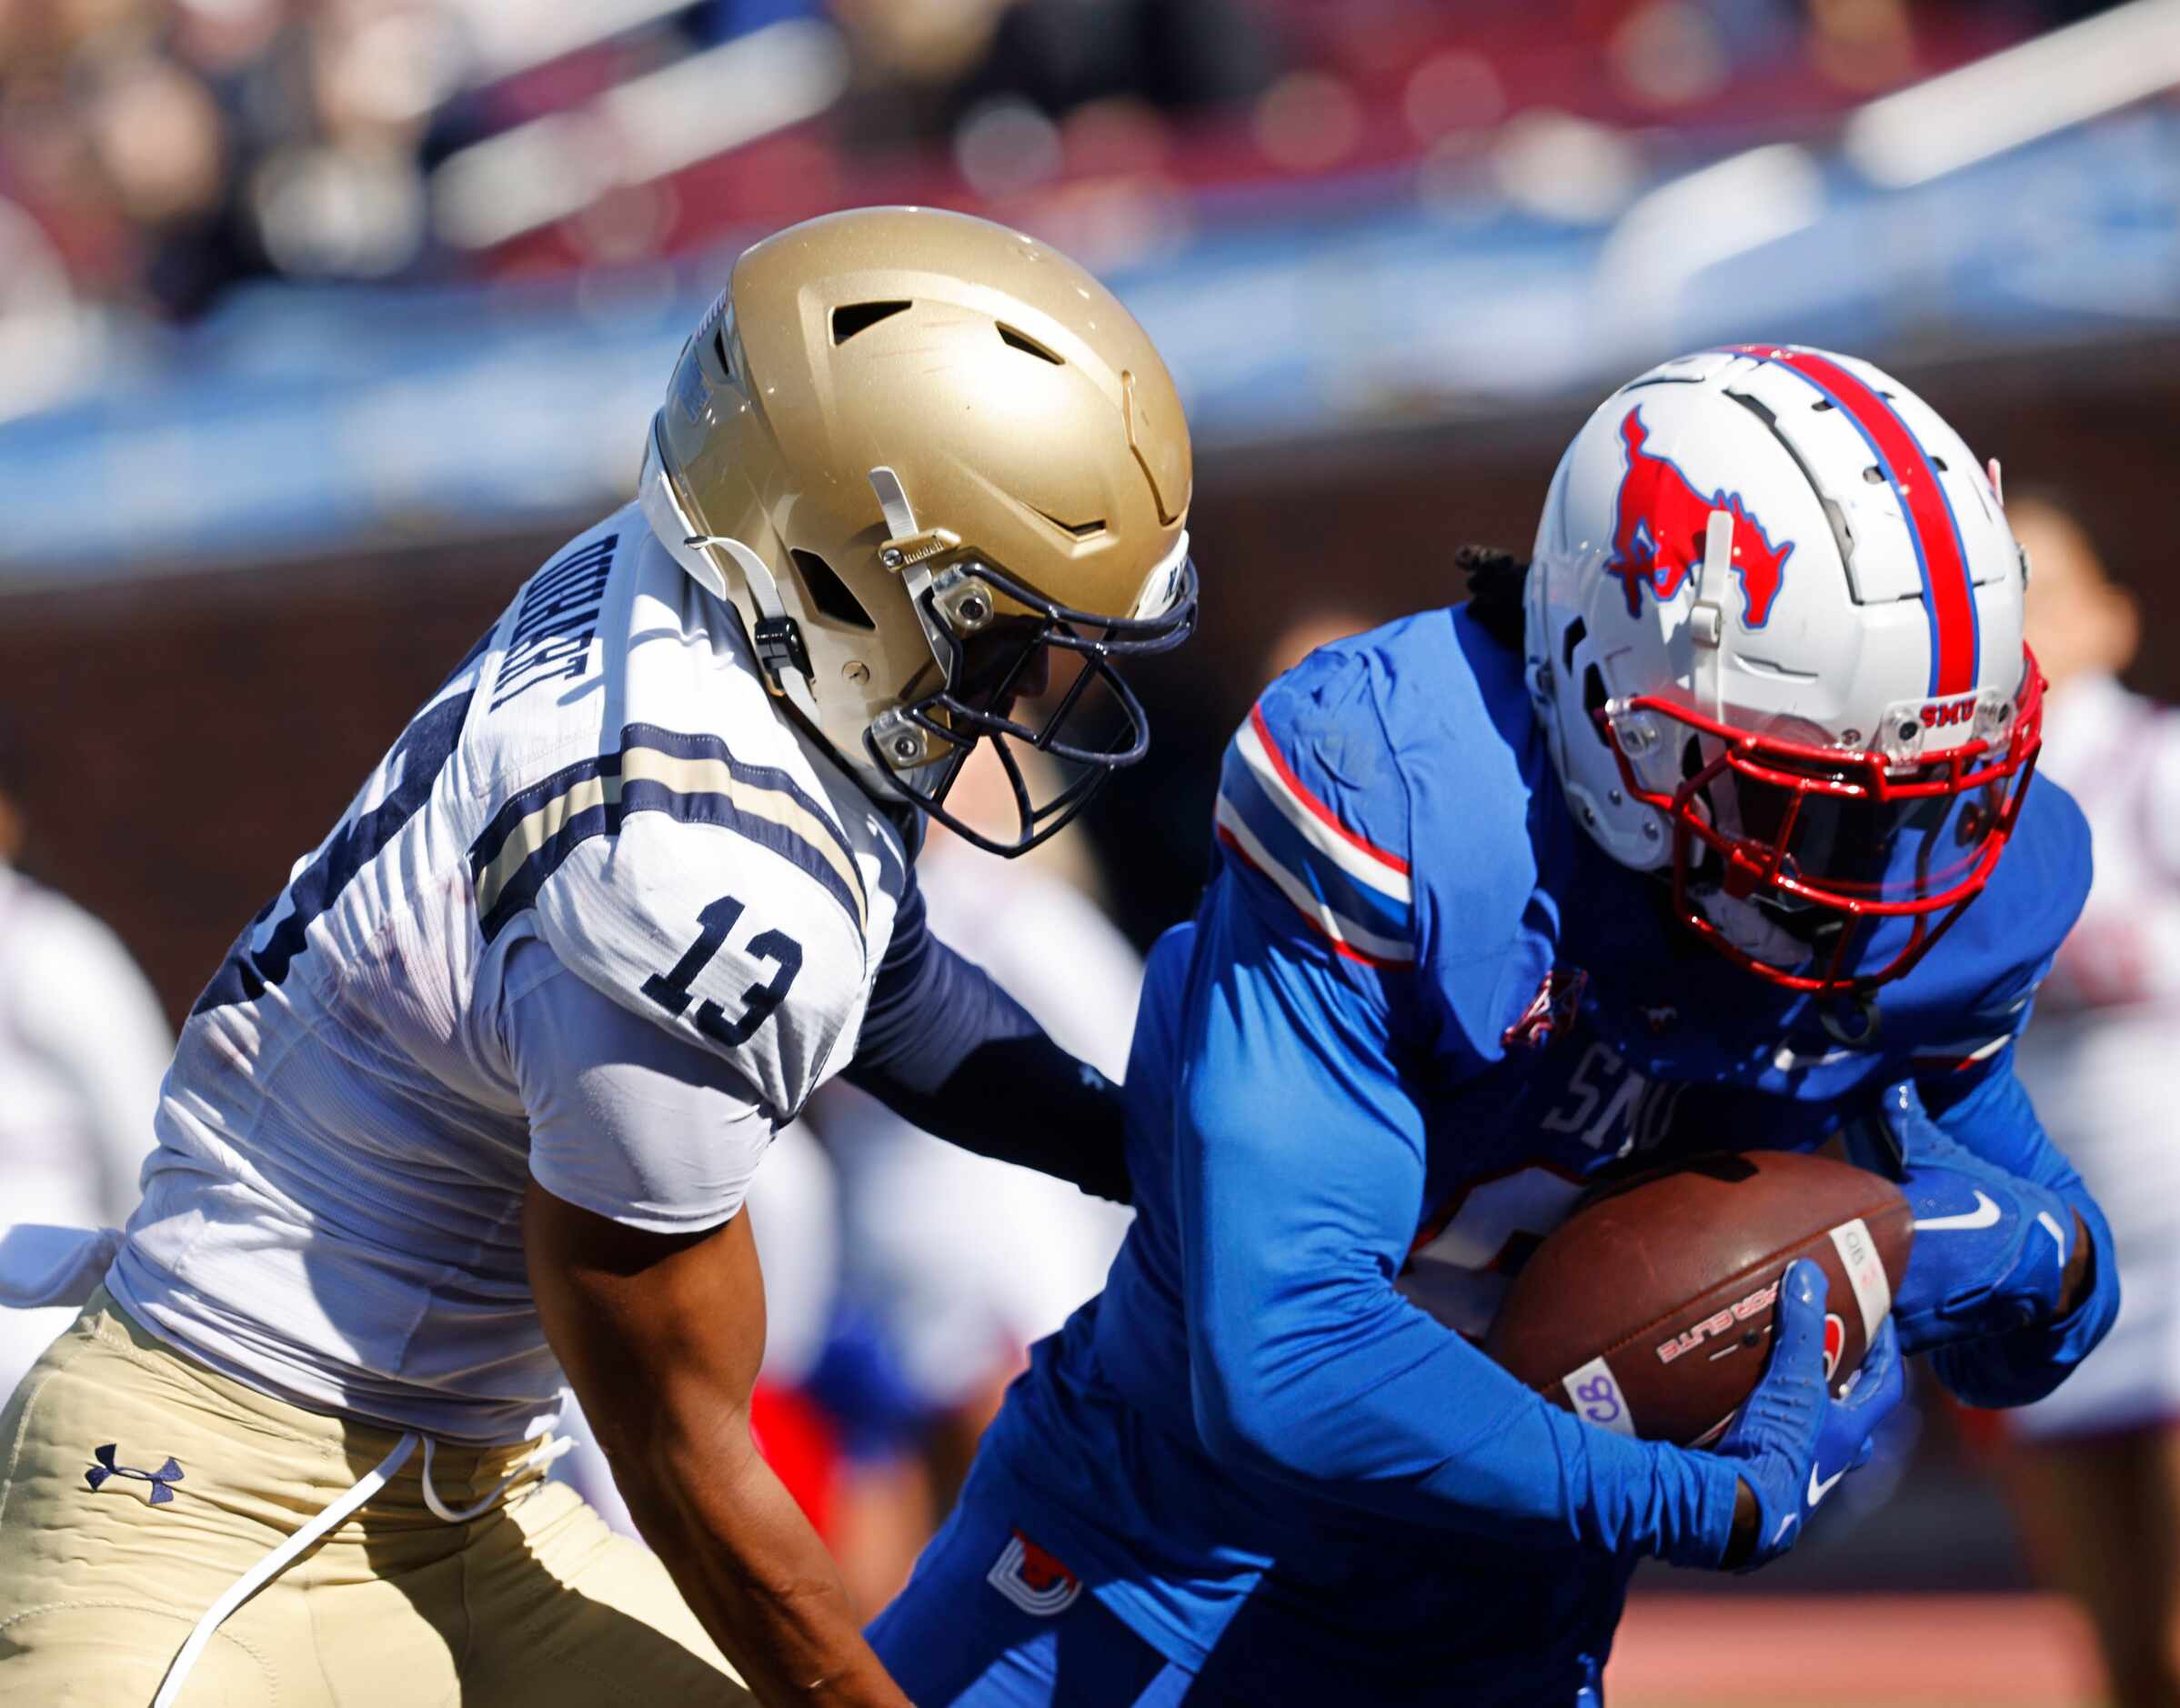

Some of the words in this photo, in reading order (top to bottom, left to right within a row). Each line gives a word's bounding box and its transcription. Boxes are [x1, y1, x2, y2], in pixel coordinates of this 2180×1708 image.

[1919, 698, 1978, 728] SMU
[639, 895, 803, 1047] 13
[1656, 1308, 1734, 1364] ELITE
